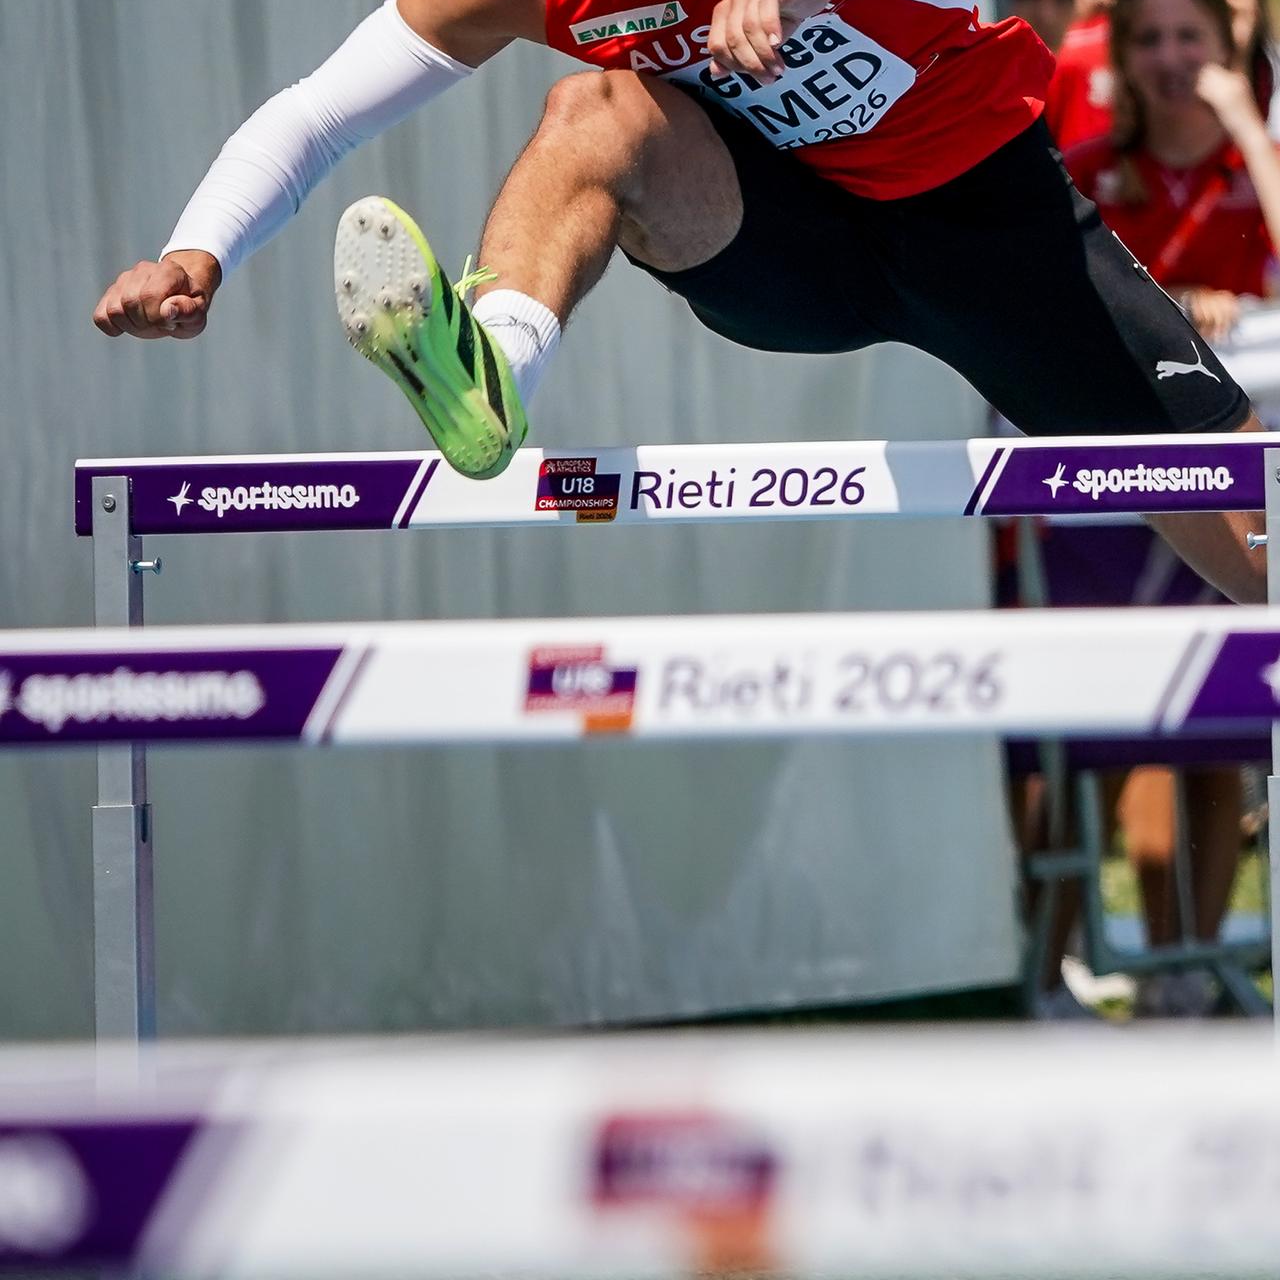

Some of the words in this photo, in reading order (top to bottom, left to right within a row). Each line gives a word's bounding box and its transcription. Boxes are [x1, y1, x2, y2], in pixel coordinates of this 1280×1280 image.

[578, 24, 623, 42] EVA
[625, 17, 658, 33] AIR
[814, 88, 887, 141] 2026
[197, 482, 361, 518] sportissimo
[562, 477, 595, 494] U18
[629, 468, 736, 510] Rieti
[749, 466, 866, 507] 2026
[1072, 464, 1235, 501] sportissimo
[538, 499, 614, 509] CHAMPIONSHIPS
[832, 650, 1005, 712] 2026
